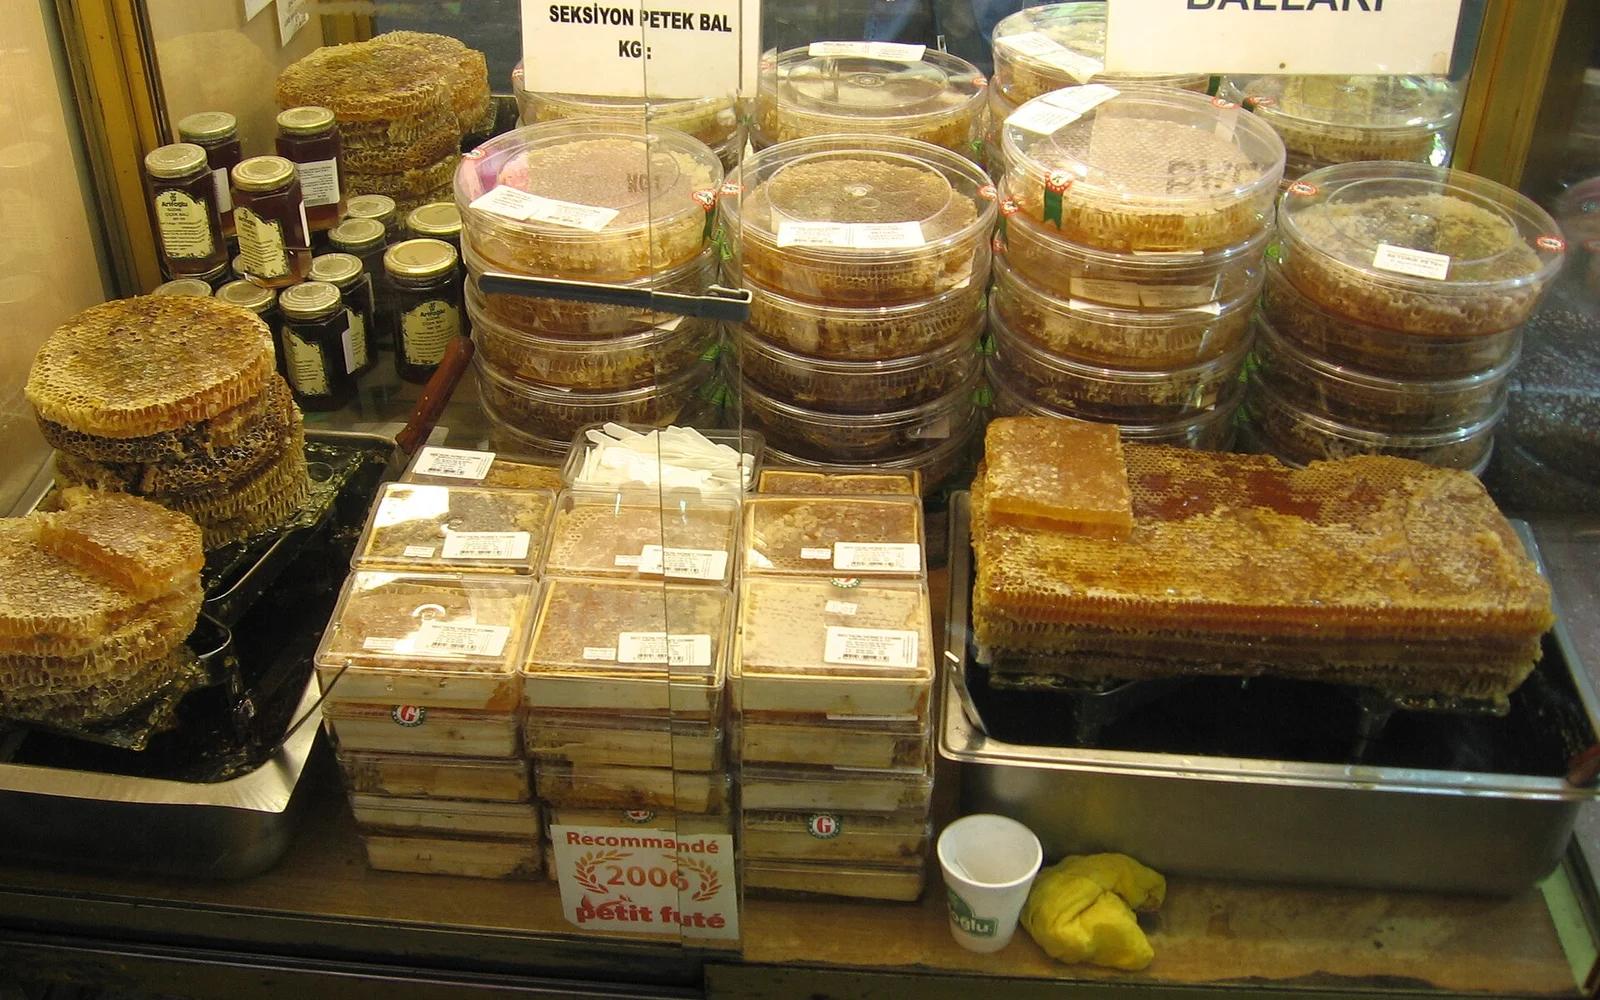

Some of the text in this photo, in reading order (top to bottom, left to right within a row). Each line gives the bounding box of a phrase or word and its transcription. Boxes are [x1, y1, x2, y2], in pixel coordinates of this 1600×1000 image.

[549, 3, 733, 33] SEKSİYON PETEK BAL
[566, 831, 720, 854] Recommandé
[605, 865, 689, 891] 2006
[576, 903, 726, 928] petit futé
